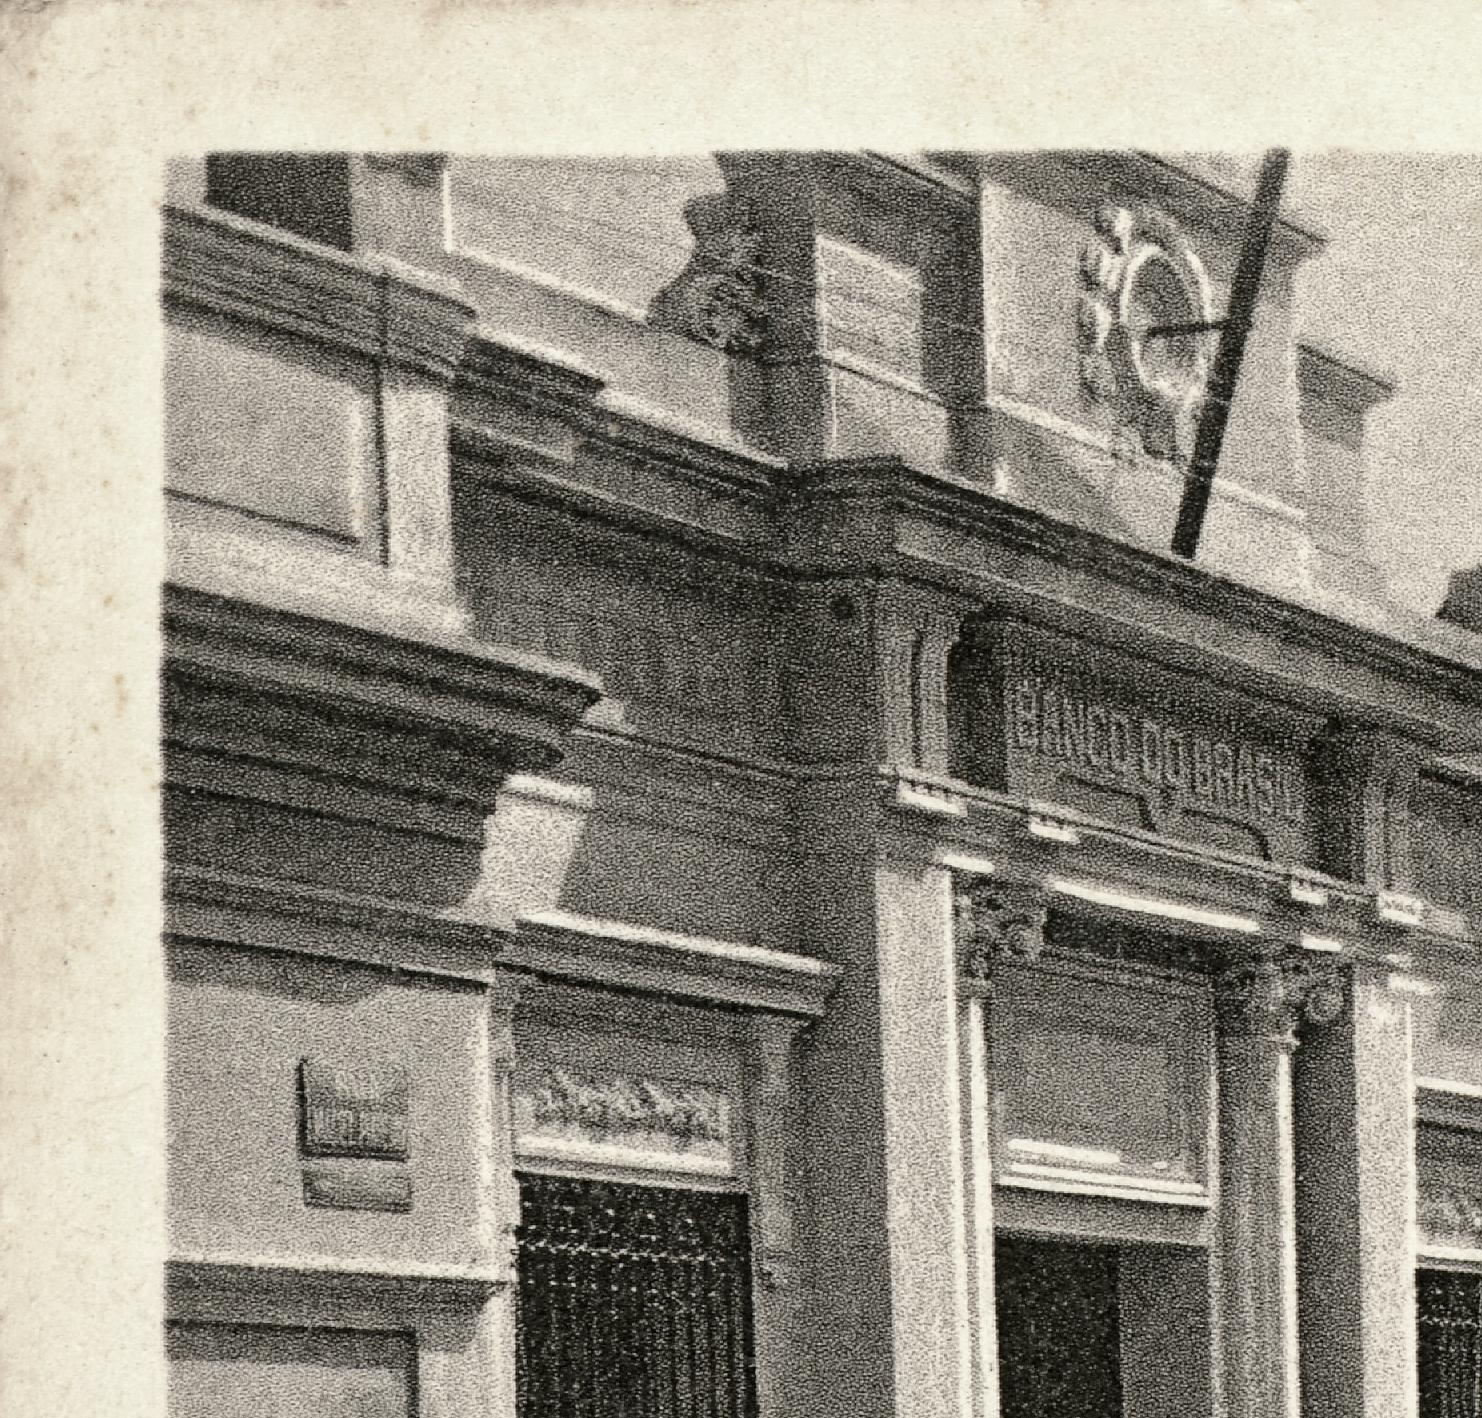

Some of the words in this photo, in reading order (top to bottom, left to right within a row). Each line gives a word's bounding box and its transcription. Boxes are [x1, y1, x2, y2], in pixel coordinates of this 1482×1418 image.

[1015, 681, 1129, 775] BANCO
[1142, 718, 1185, 788] DO
[1193, 737, 1303, 823] BRASIL
